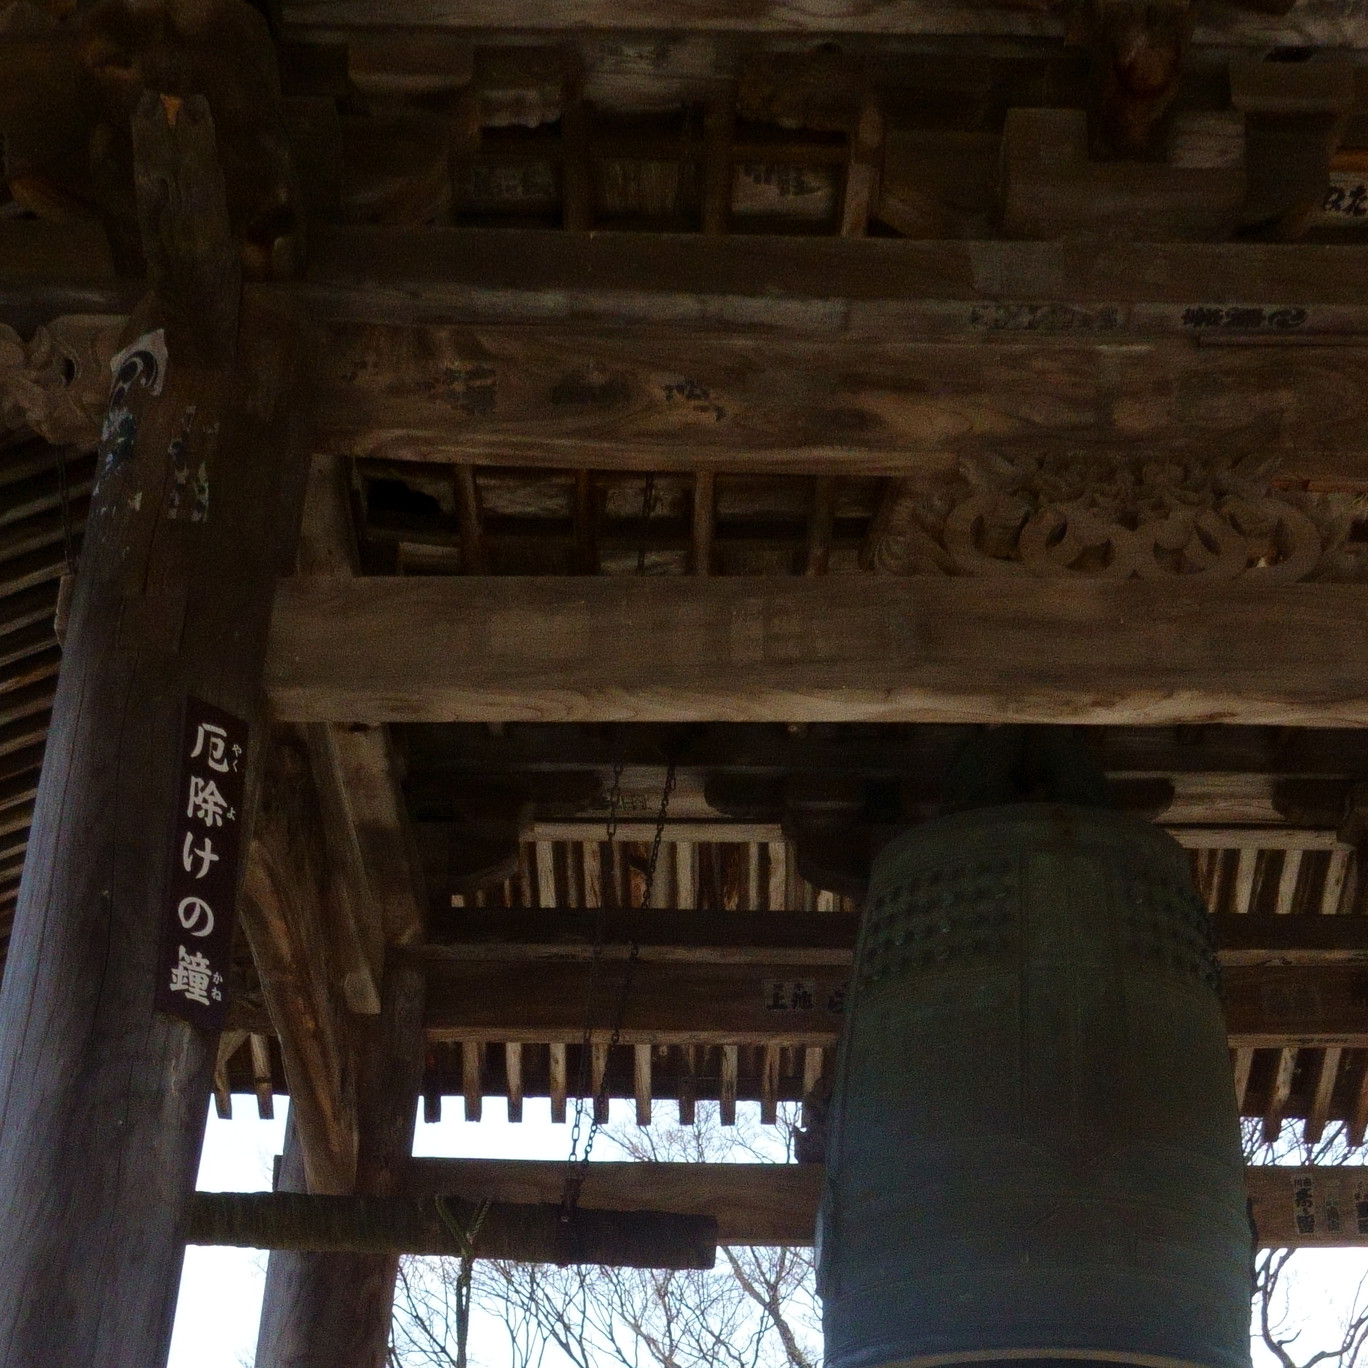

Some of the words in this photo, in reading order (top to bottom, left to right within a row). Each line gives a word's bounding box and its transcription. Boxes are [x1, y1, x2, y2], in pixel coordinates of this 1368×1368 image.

[170, 723, 229, 1006] 厄除けの鐘
